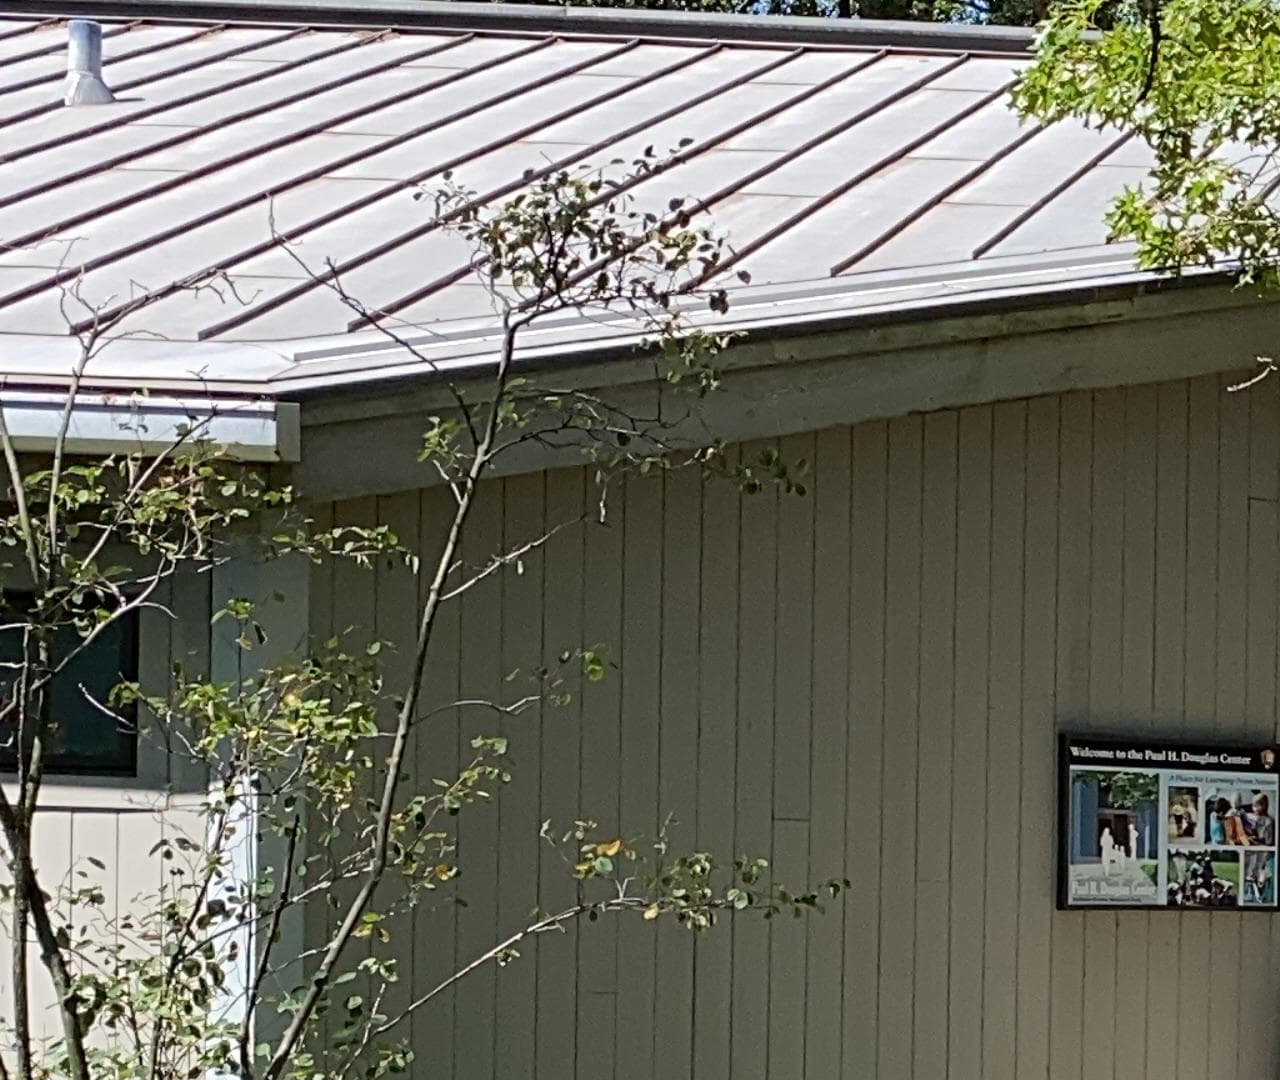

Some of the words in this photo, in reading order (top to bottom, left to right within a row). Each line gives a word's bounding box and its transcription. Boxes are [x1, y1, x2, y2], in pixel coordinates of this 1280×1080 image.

[1069, 746, 1114, 759] Welcome
[1116, 749, 1126, 760] to
[1127, 749, 1143, 760] the
[1145, 749, 1166, 761] Paul
[1181, 751, 1218, 765] Douglas
[1220, 753, 1251, 765] Center
